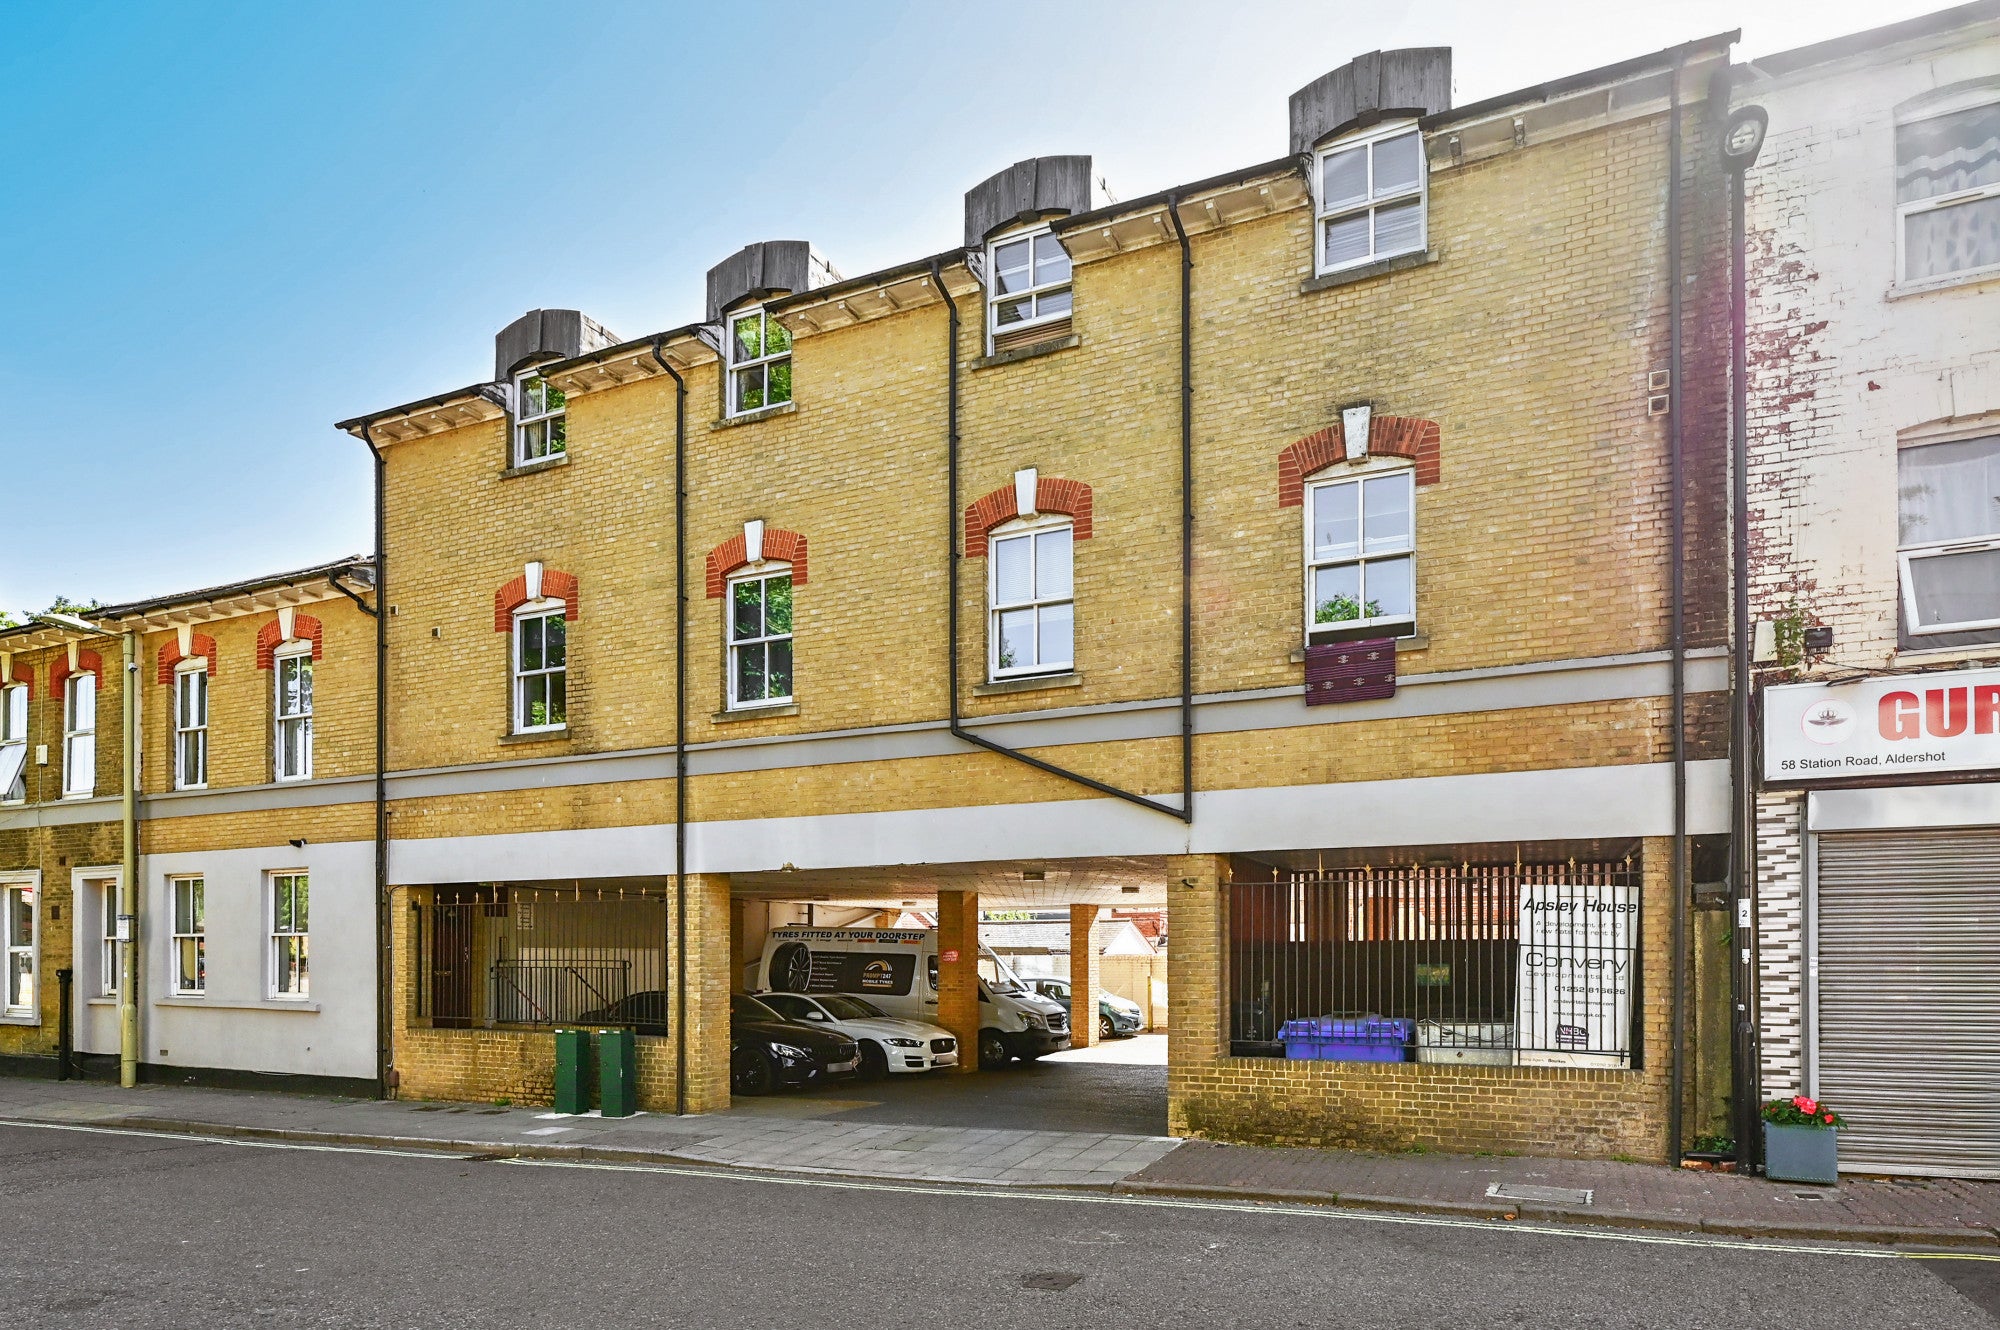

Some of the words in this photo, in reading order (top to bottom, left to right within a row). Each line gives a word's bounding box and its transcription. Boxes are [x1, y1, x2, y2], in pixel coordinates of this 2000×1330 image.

[1781, 760, 1796, 770] 58
[1800, 758, 1842, 769] Station
[1845, 755, 1882, 767] Road,
[1885, 751, 1946, 764] Aldershot
[1523, 898, 1578, 915] Apsley
[1583, 899, 1637, 914] House
[849, 931, 873, 939] YOUR
[876, 931, 925, 940] DOORSTEP
[1526, 952, 1627, 973] Convery
